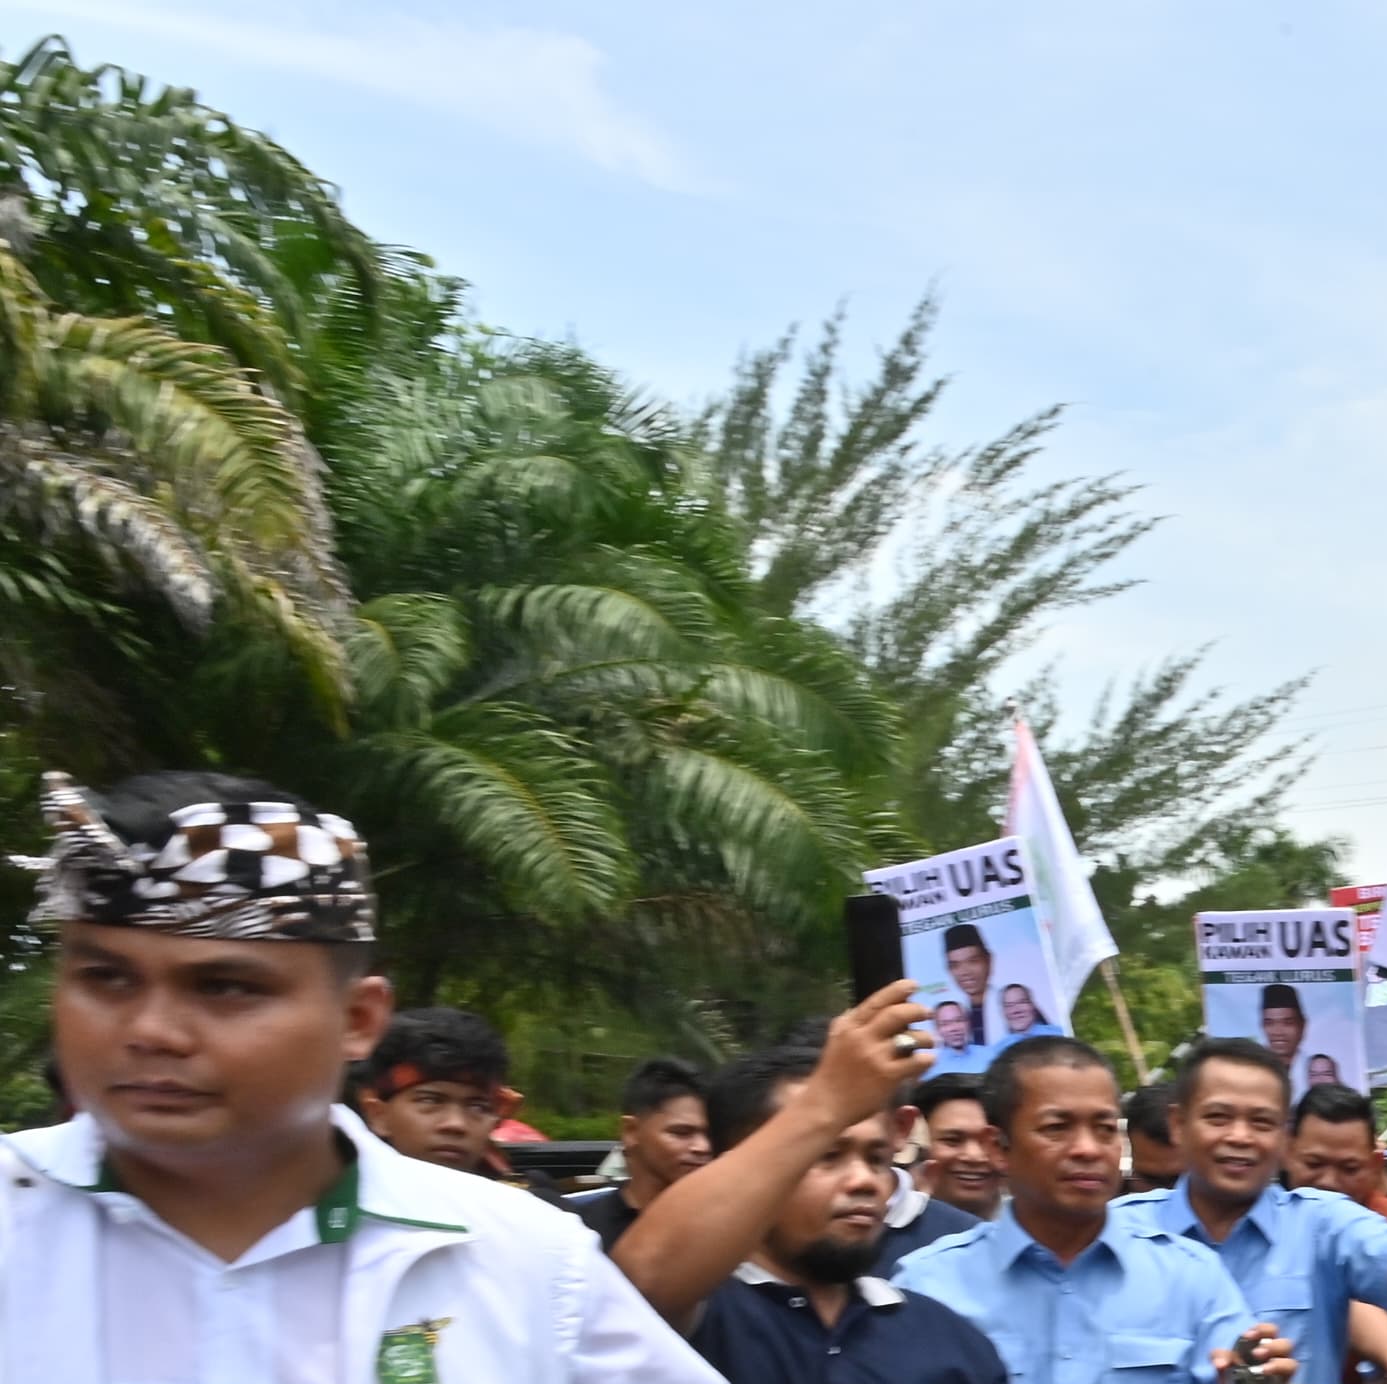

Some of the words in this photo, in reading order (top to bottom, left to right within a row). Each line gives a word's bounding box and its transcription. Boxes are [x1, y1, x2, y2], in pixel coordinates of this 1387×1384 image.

[870, 868, 943, 894] PILIH
[948, 850, 1024, 896] UAS
[1199, 923, 1273, 943] PILIH
[1280, 920, 1351, 958] UAS
[1280, 970, 1336, 982] LURUS
